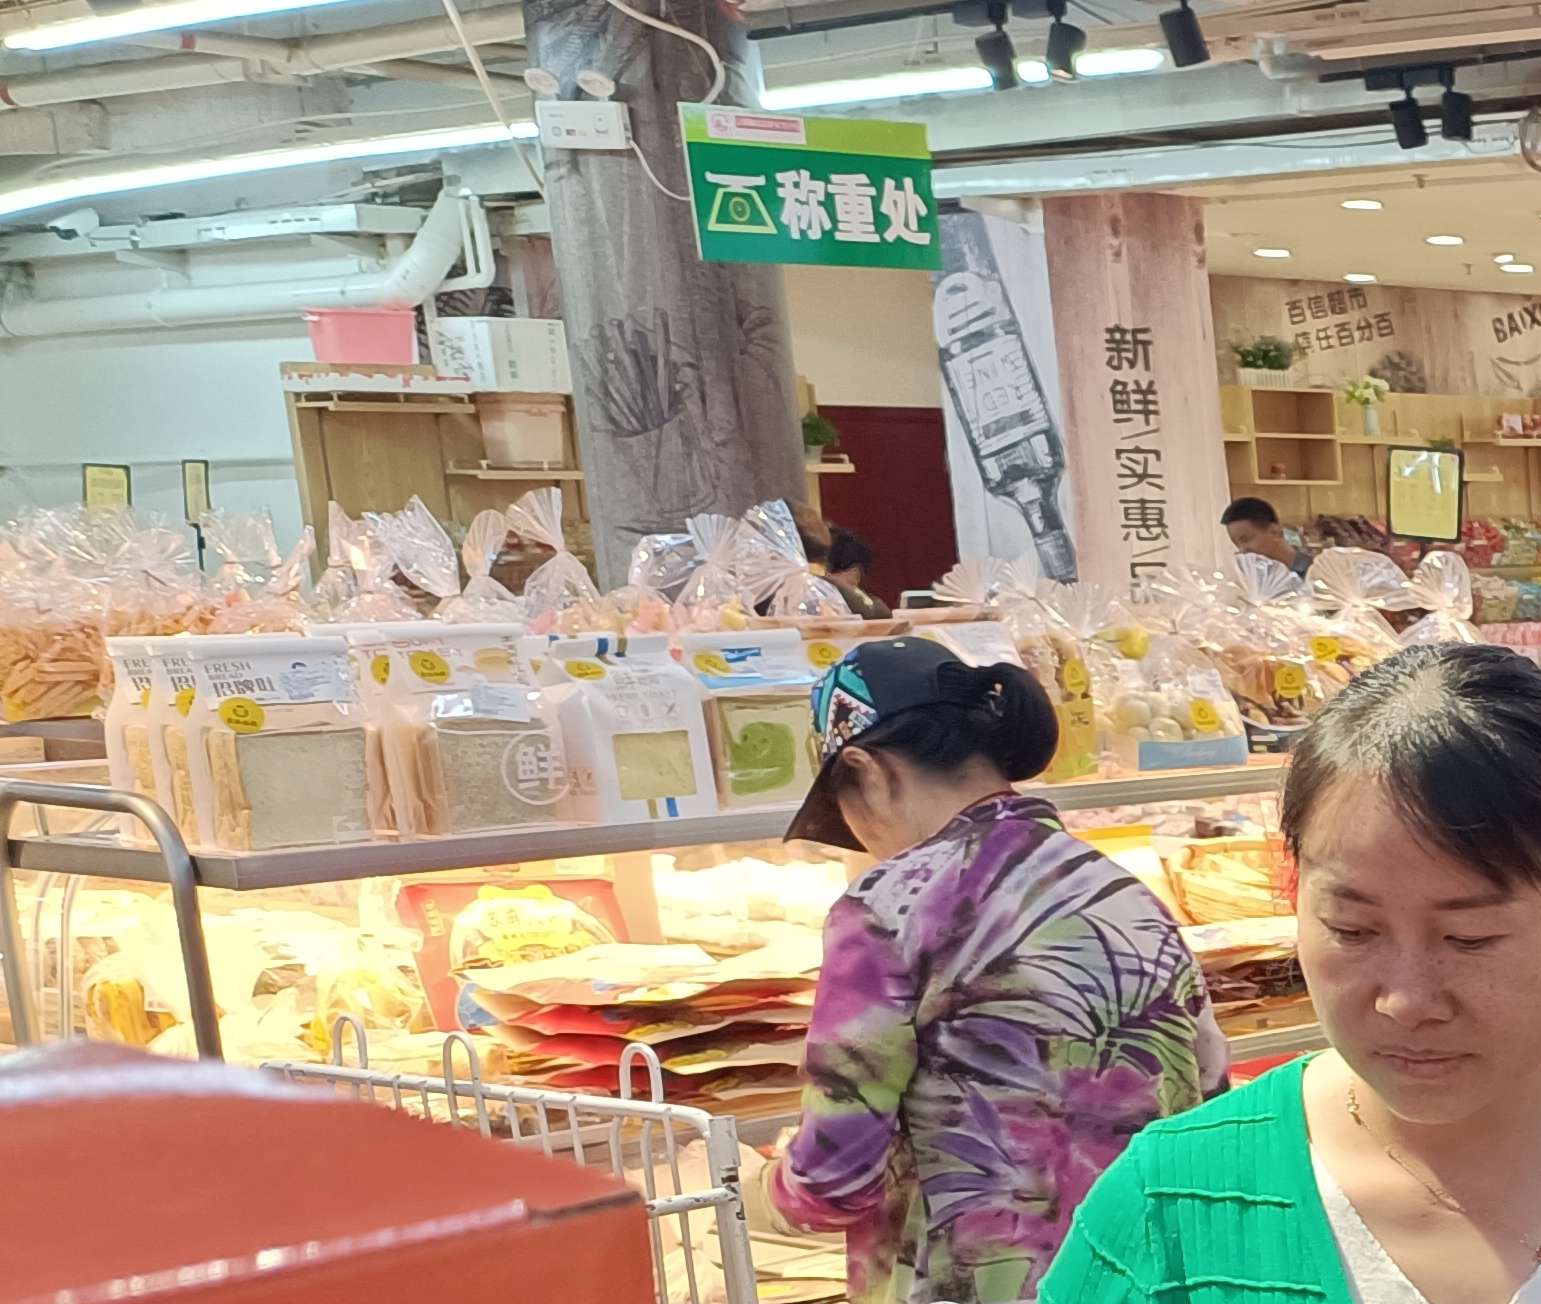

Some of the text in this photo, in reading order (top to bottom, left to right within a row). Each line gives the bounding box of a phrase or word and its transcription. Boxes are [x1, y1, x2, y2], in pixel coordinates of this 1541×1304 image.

[774, 168, 932, 246] 称重处
[1285, 287, 1368, 326] 百信超市
[1294, 311, 1396, 353] 信任百分百
[203, 661, 252, 675] FRESH
